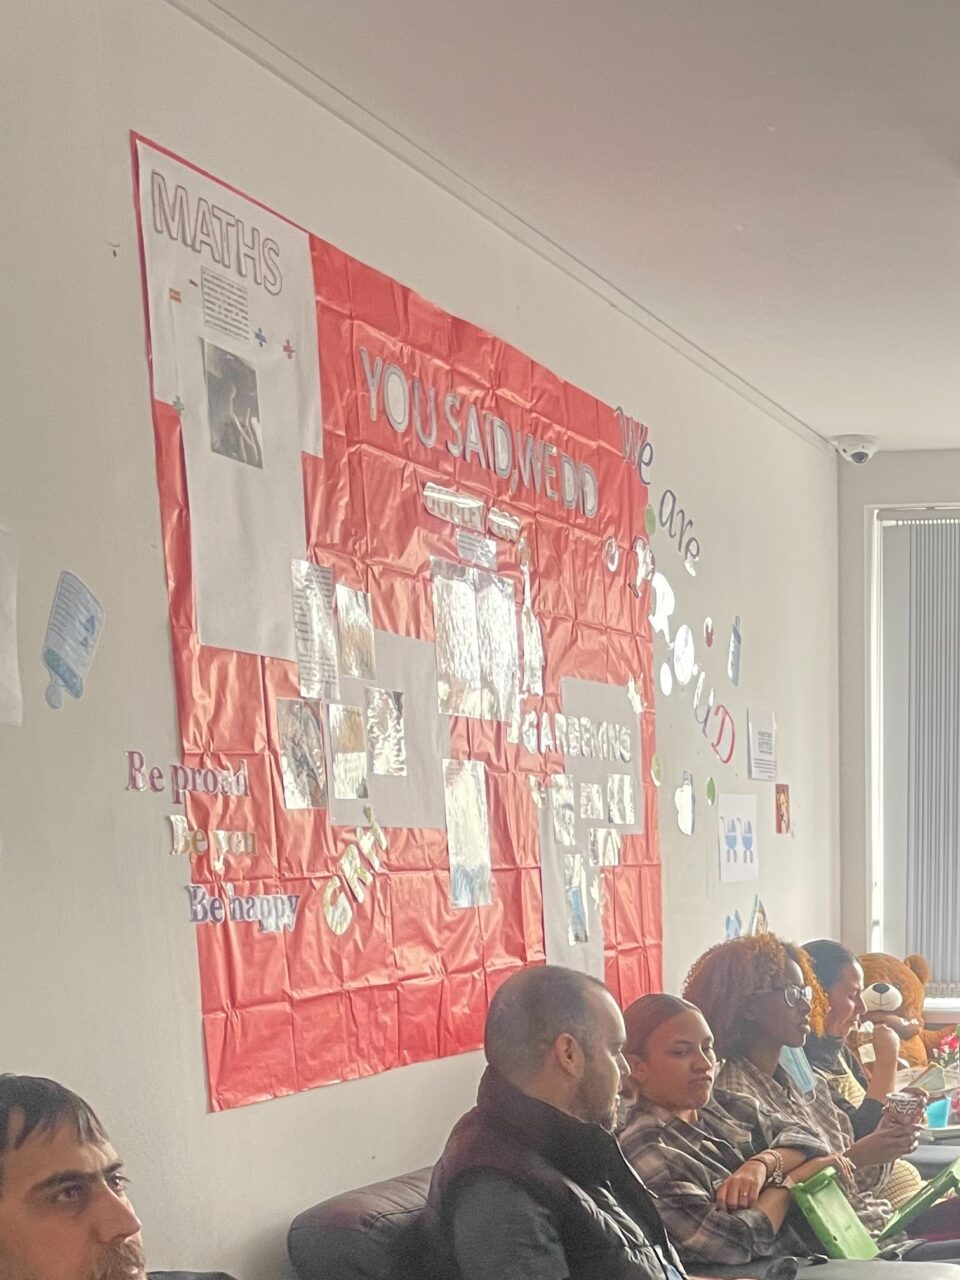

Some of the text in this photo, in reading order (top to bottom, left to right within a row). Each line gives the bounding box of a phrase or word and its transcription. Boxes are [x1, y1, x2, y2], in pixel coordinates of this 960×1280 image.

[151, 169, 283, 296] MATHS
[358, 346, 438, 449] YOU
[514, 429, 558, 500] WE
[614, 406, 701, 577] We are
[126, 750, 165, 792] Be
[168, 814, 258, 874] Be you
[184, 881, 301, 932] Be happy
